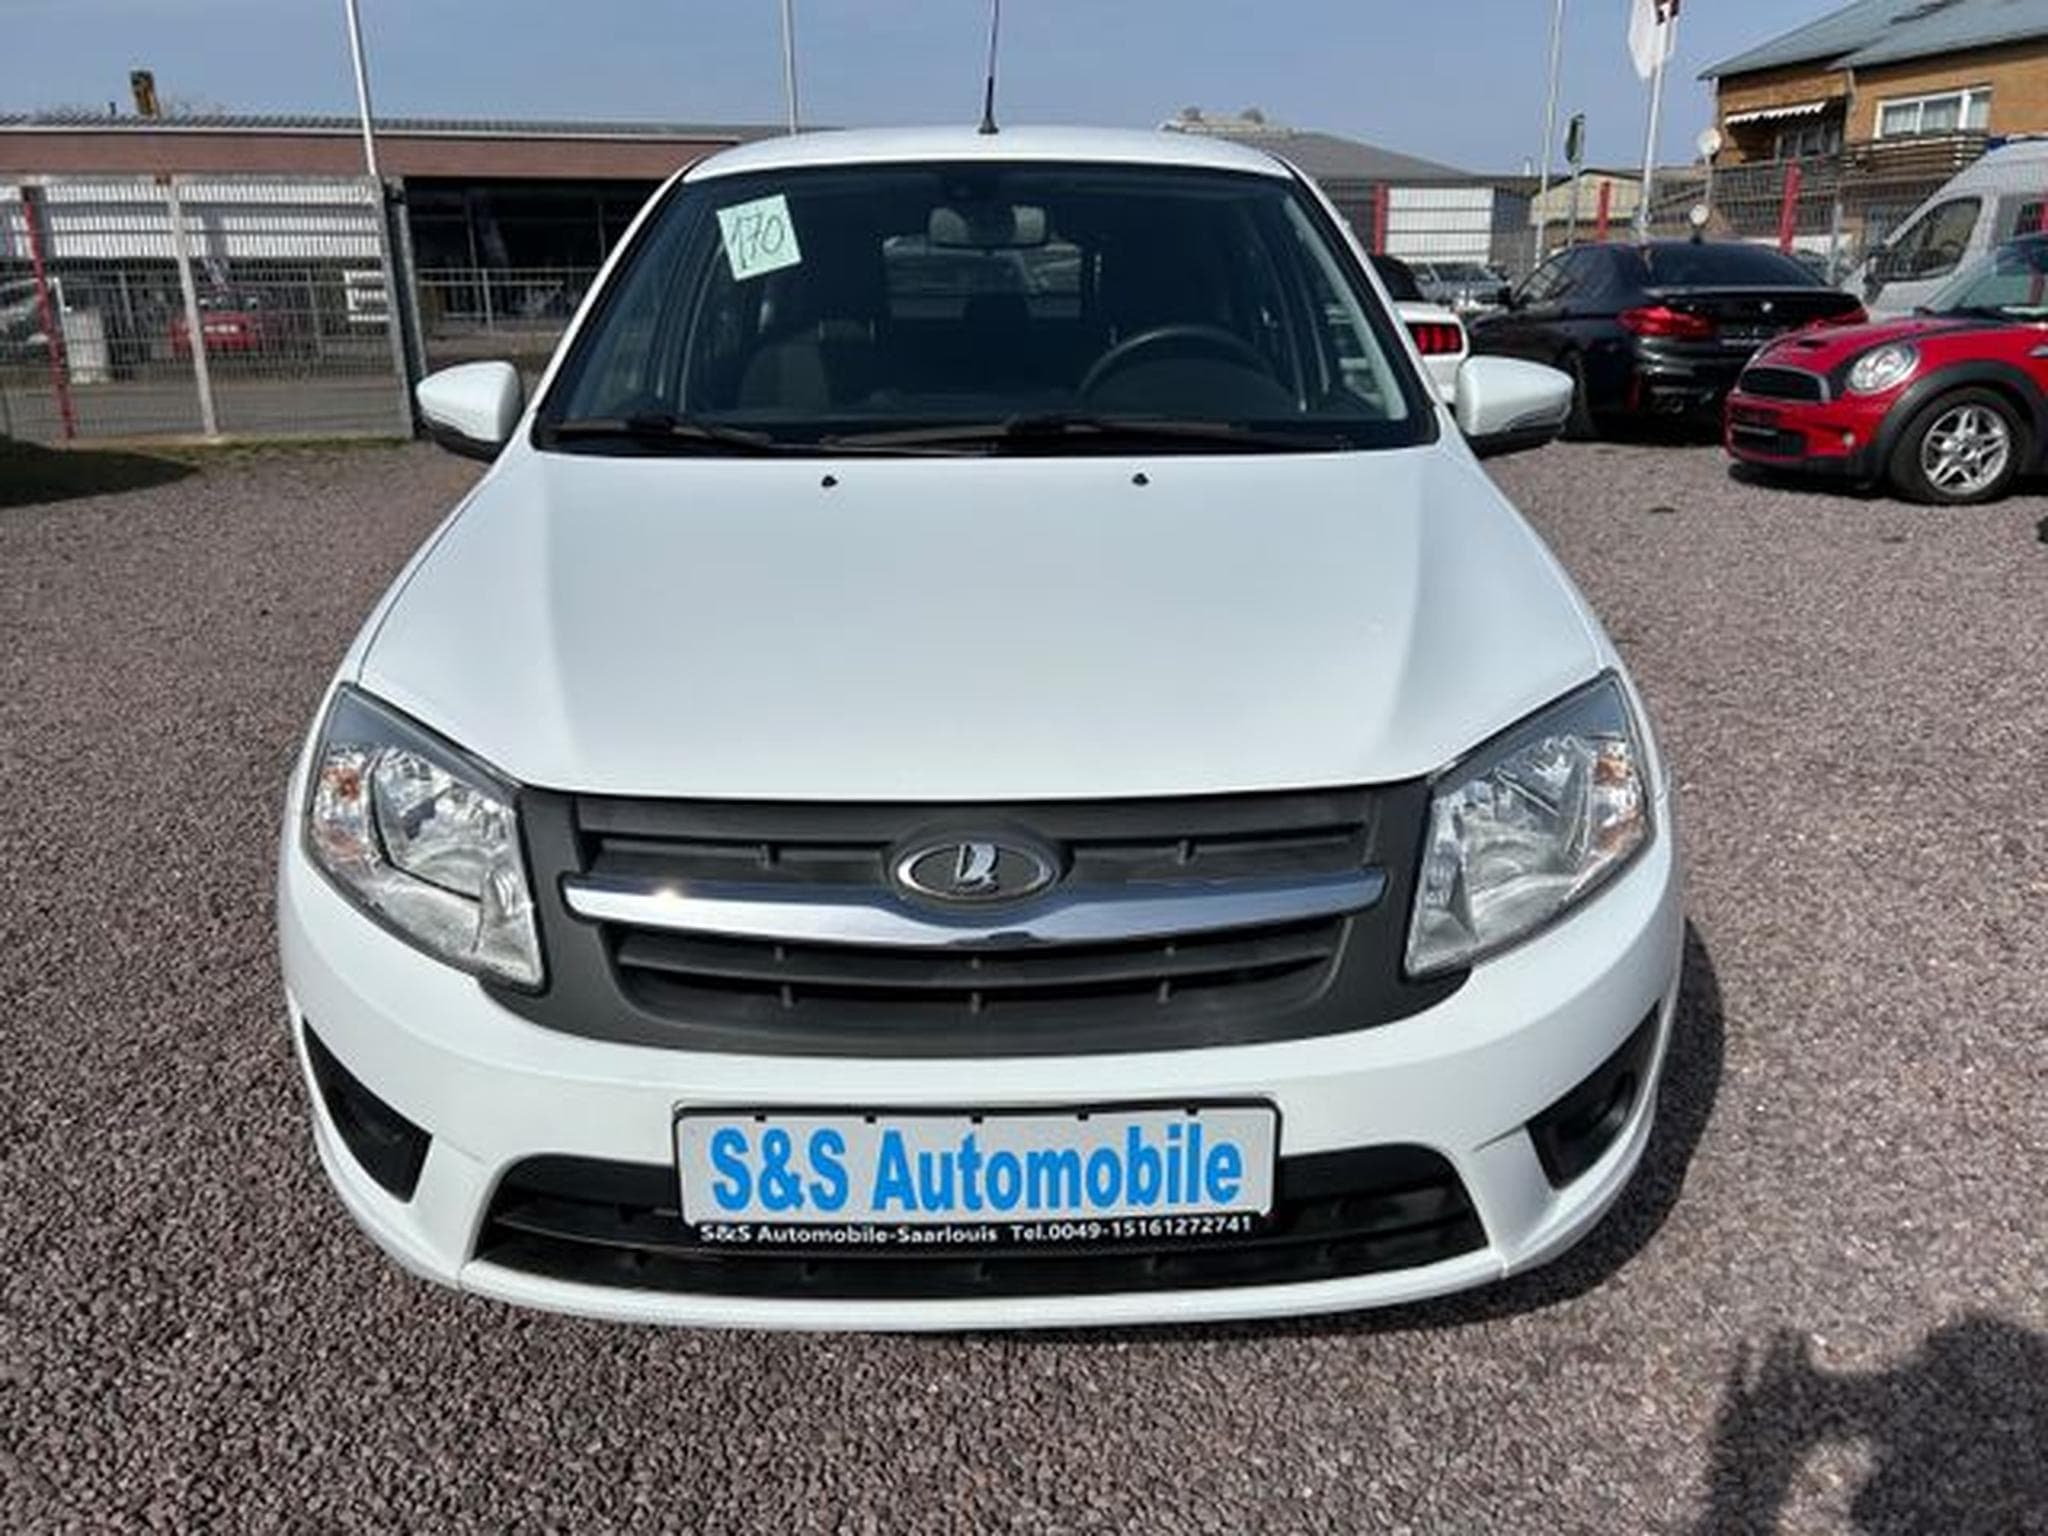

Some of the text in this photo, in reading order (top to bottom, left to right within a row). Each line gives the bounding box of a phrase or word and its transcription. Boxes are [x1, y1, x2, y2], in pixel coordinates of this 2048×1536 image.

[710, 1123, 1243, 1212] S&S Automobile
[700, 1215, 1251, 1244] S&S Automobile-Saarlouis Tel.0049-15161272741
